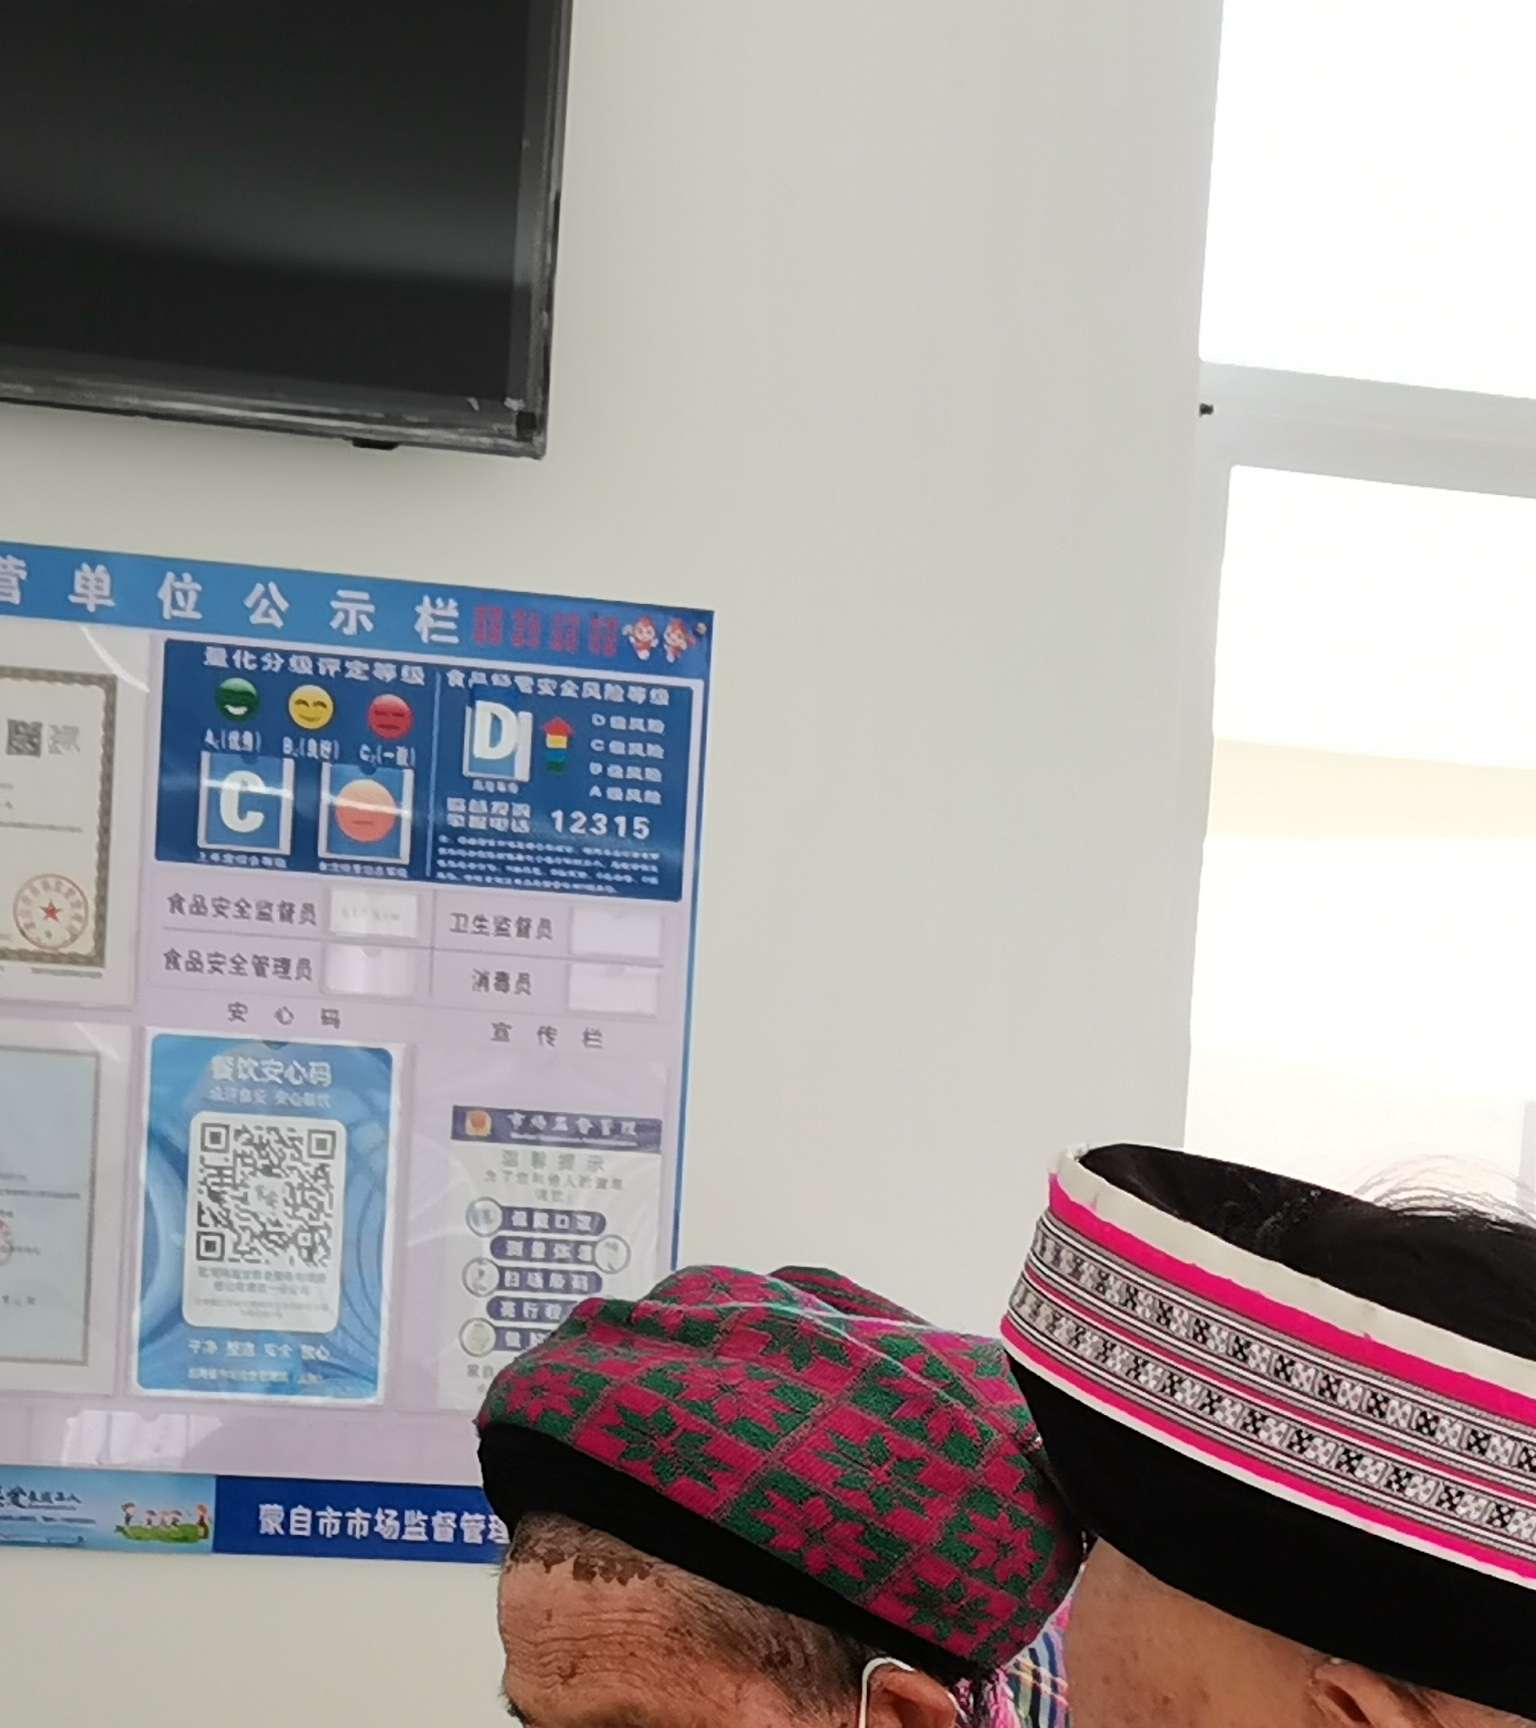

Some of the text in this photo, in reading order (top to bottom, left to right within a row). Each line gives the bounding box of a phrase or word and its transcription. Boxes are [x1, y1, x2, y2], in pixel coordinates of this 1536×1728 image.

[203, 646, 425, 685] 量化分级评定等级
[473, 700, 517, 759] D
[220, 770, 264, 833] C
[551, 809, 650, 839] 12315
[168, 892, 317, 925] 食品安全监督员
[450, 912, 552, 940] 卫生监督员
[164, 948, 312, 981] 食品安全管理员
[472, 968, 531, 995] 消毒员
[227, 1001, 341, 1029] 安心码
[491, 1022, 603, 1048] 宣传栏
[211, 1056, 332, 1087] 餐饮安心码
